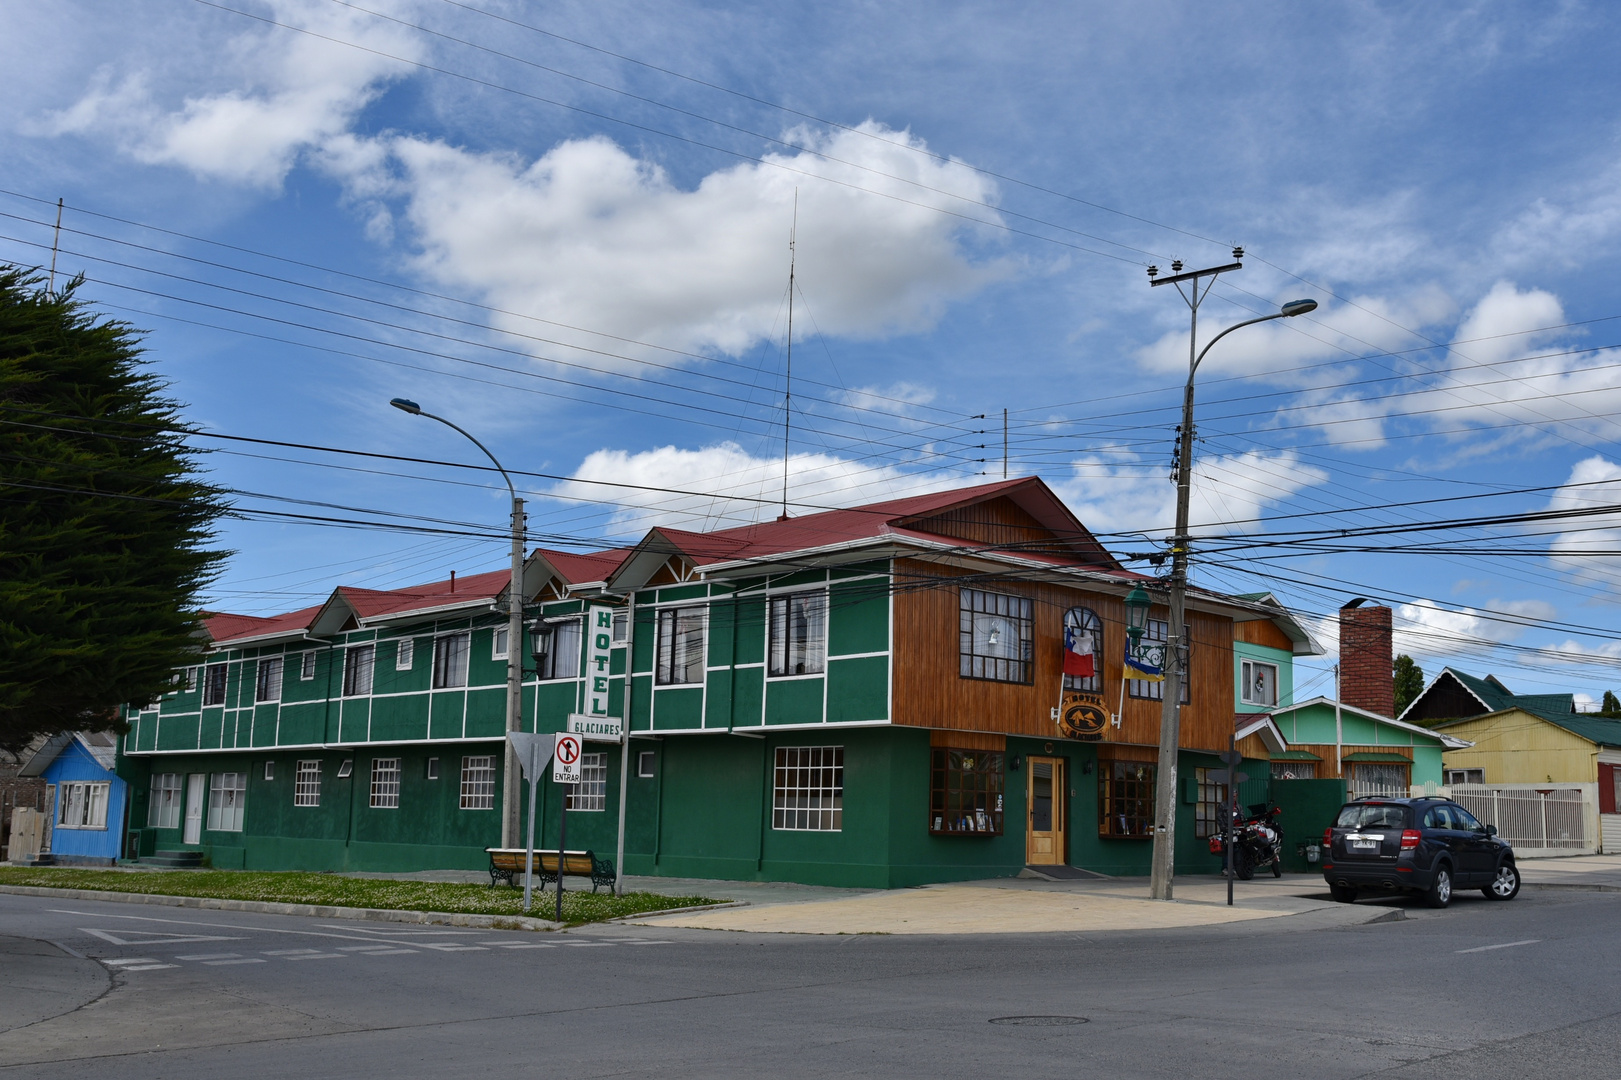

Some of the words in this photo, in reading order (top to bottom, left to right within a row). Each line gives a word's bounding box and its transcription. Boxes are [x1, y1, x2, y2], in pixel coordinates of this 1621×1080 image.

[592, 611, 611, 715] HOTEL
[1072, 694, 1101, 705] HOTEL
[575, 722, 620, 736] GLACIARES
[563, 765, 572, 773] NO
[554, 772, 580, 782] ENTRAR
